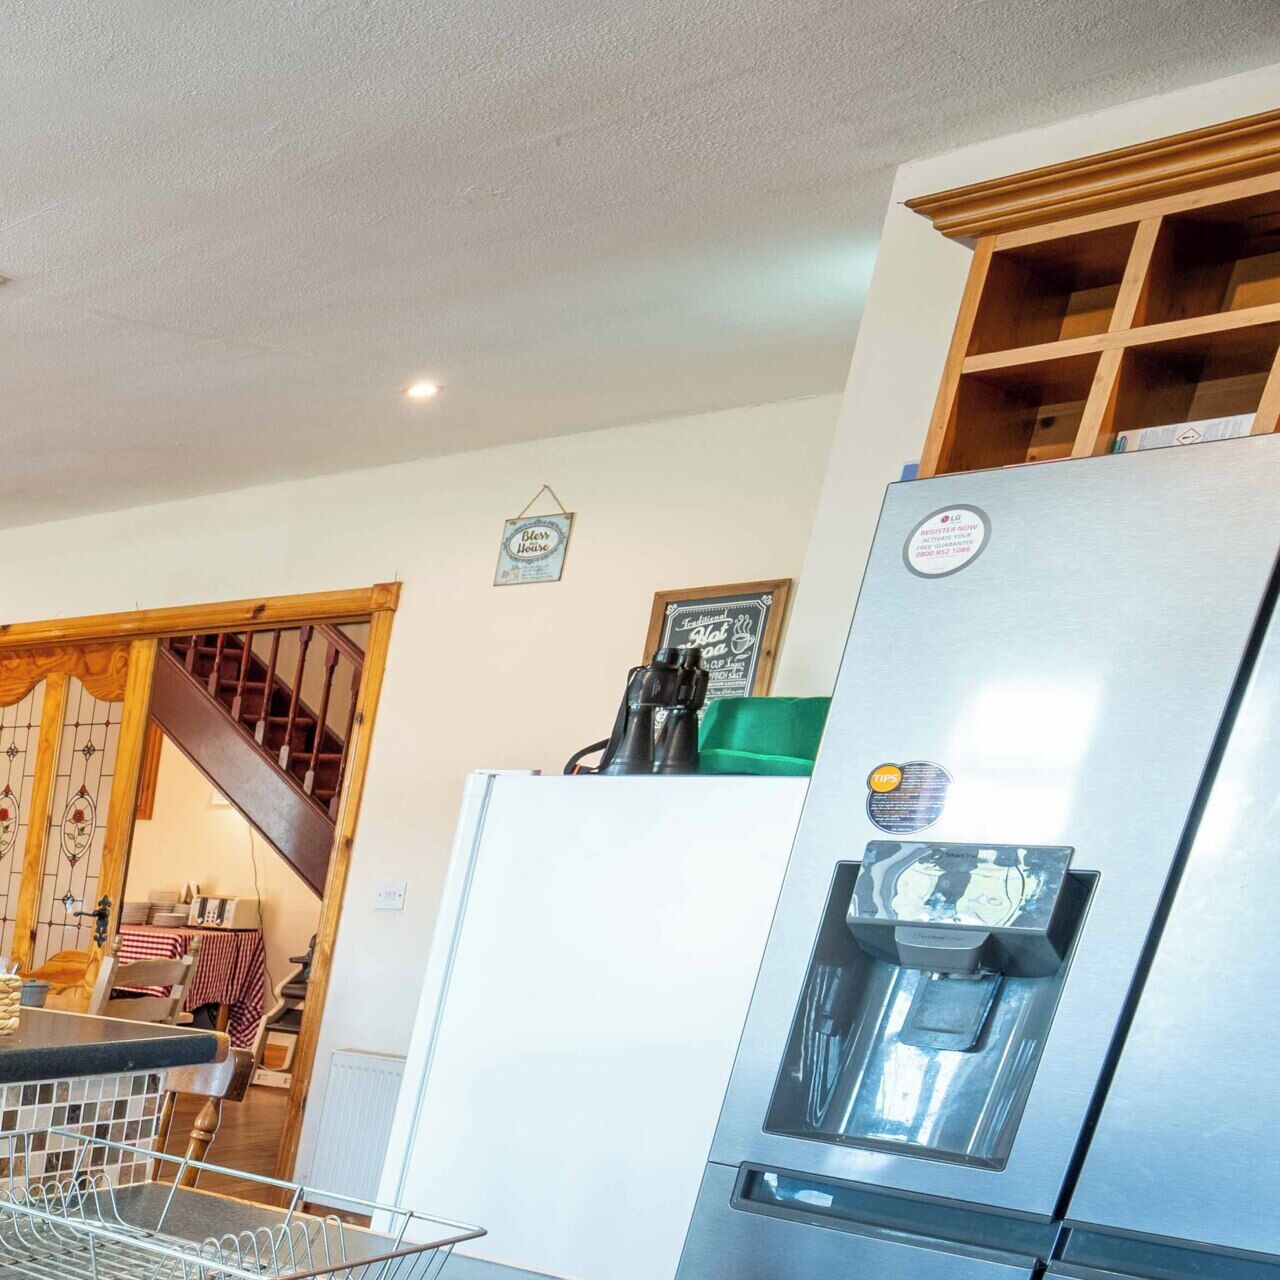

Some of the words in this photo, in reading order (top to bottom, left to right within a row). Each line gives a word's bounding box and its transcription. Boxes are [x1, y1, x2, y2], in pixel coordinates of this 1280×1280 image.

[522, 530, 550, 541] Bless
[921, 527, 956, 536] REGISTER
[957, 524, 979, 532] NOW
[517, 543, 549, 554] House
[681, 609, 728, 628] Traditional
[687, 622, 728, 648] Hot
[710, 659, 725, 669] CUP
[728, 671, 743, 680] SALT
[873, 773, 898, 783] TIPS
